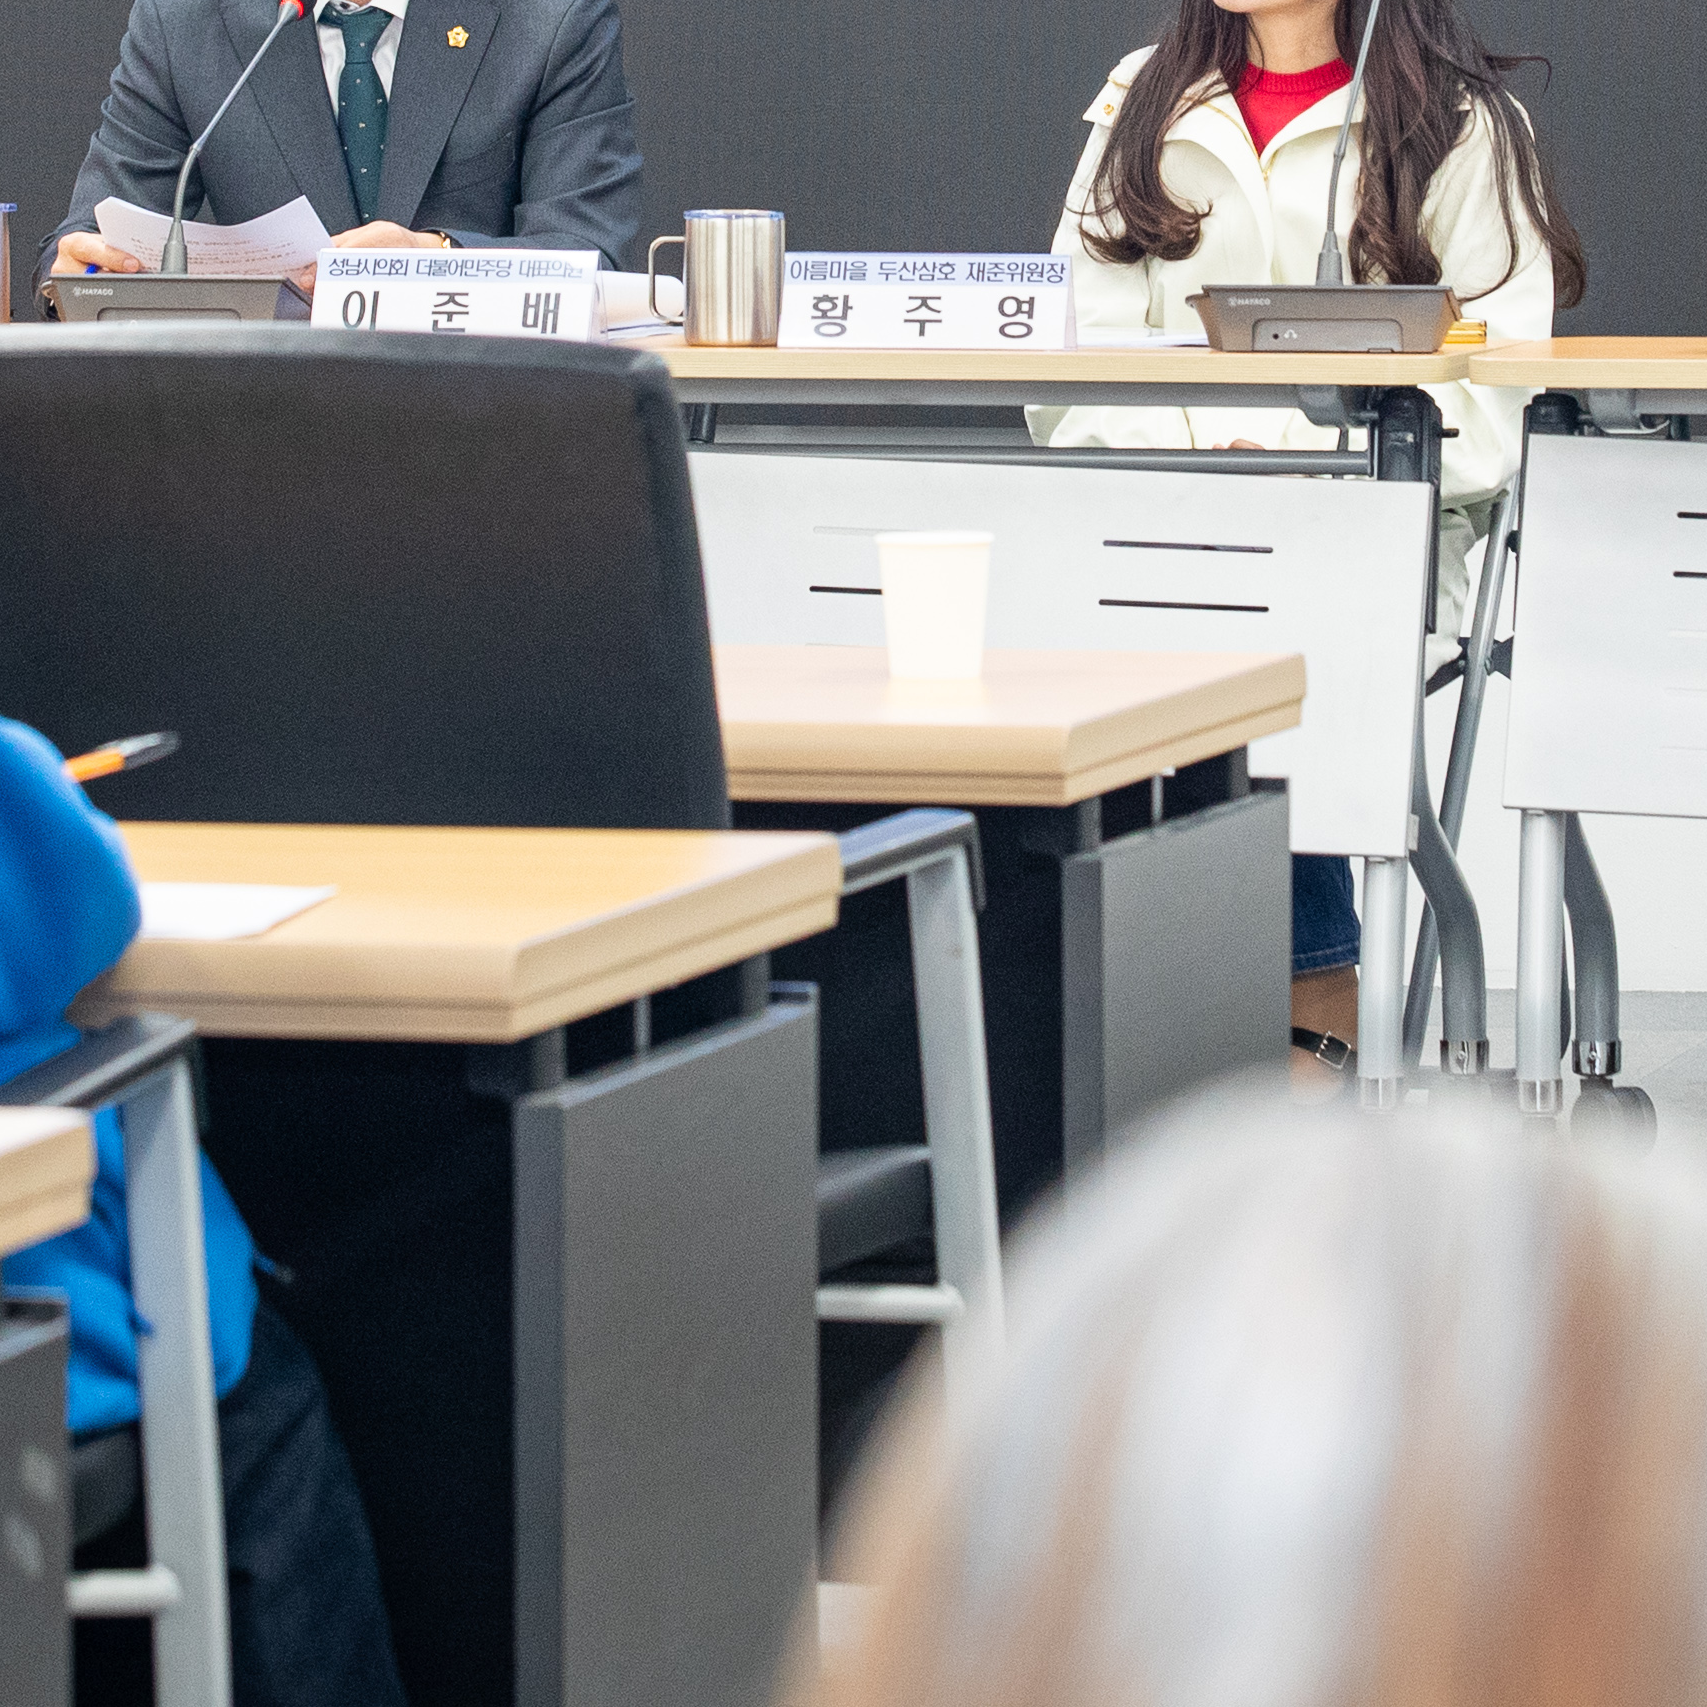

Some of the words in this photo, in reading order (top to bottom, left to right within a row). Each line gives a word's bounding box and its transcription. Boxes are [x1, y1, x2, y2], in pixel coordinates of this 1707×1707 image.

[328, 258, 409, 277] 성남시의회
[416, 258, 512, 278] 더불어민주당
[790, 260, 868, 281] 아름마을
[878, 261, 956, 282] 두산삼호
[965, 262, 1066, 284] 재준위원장
